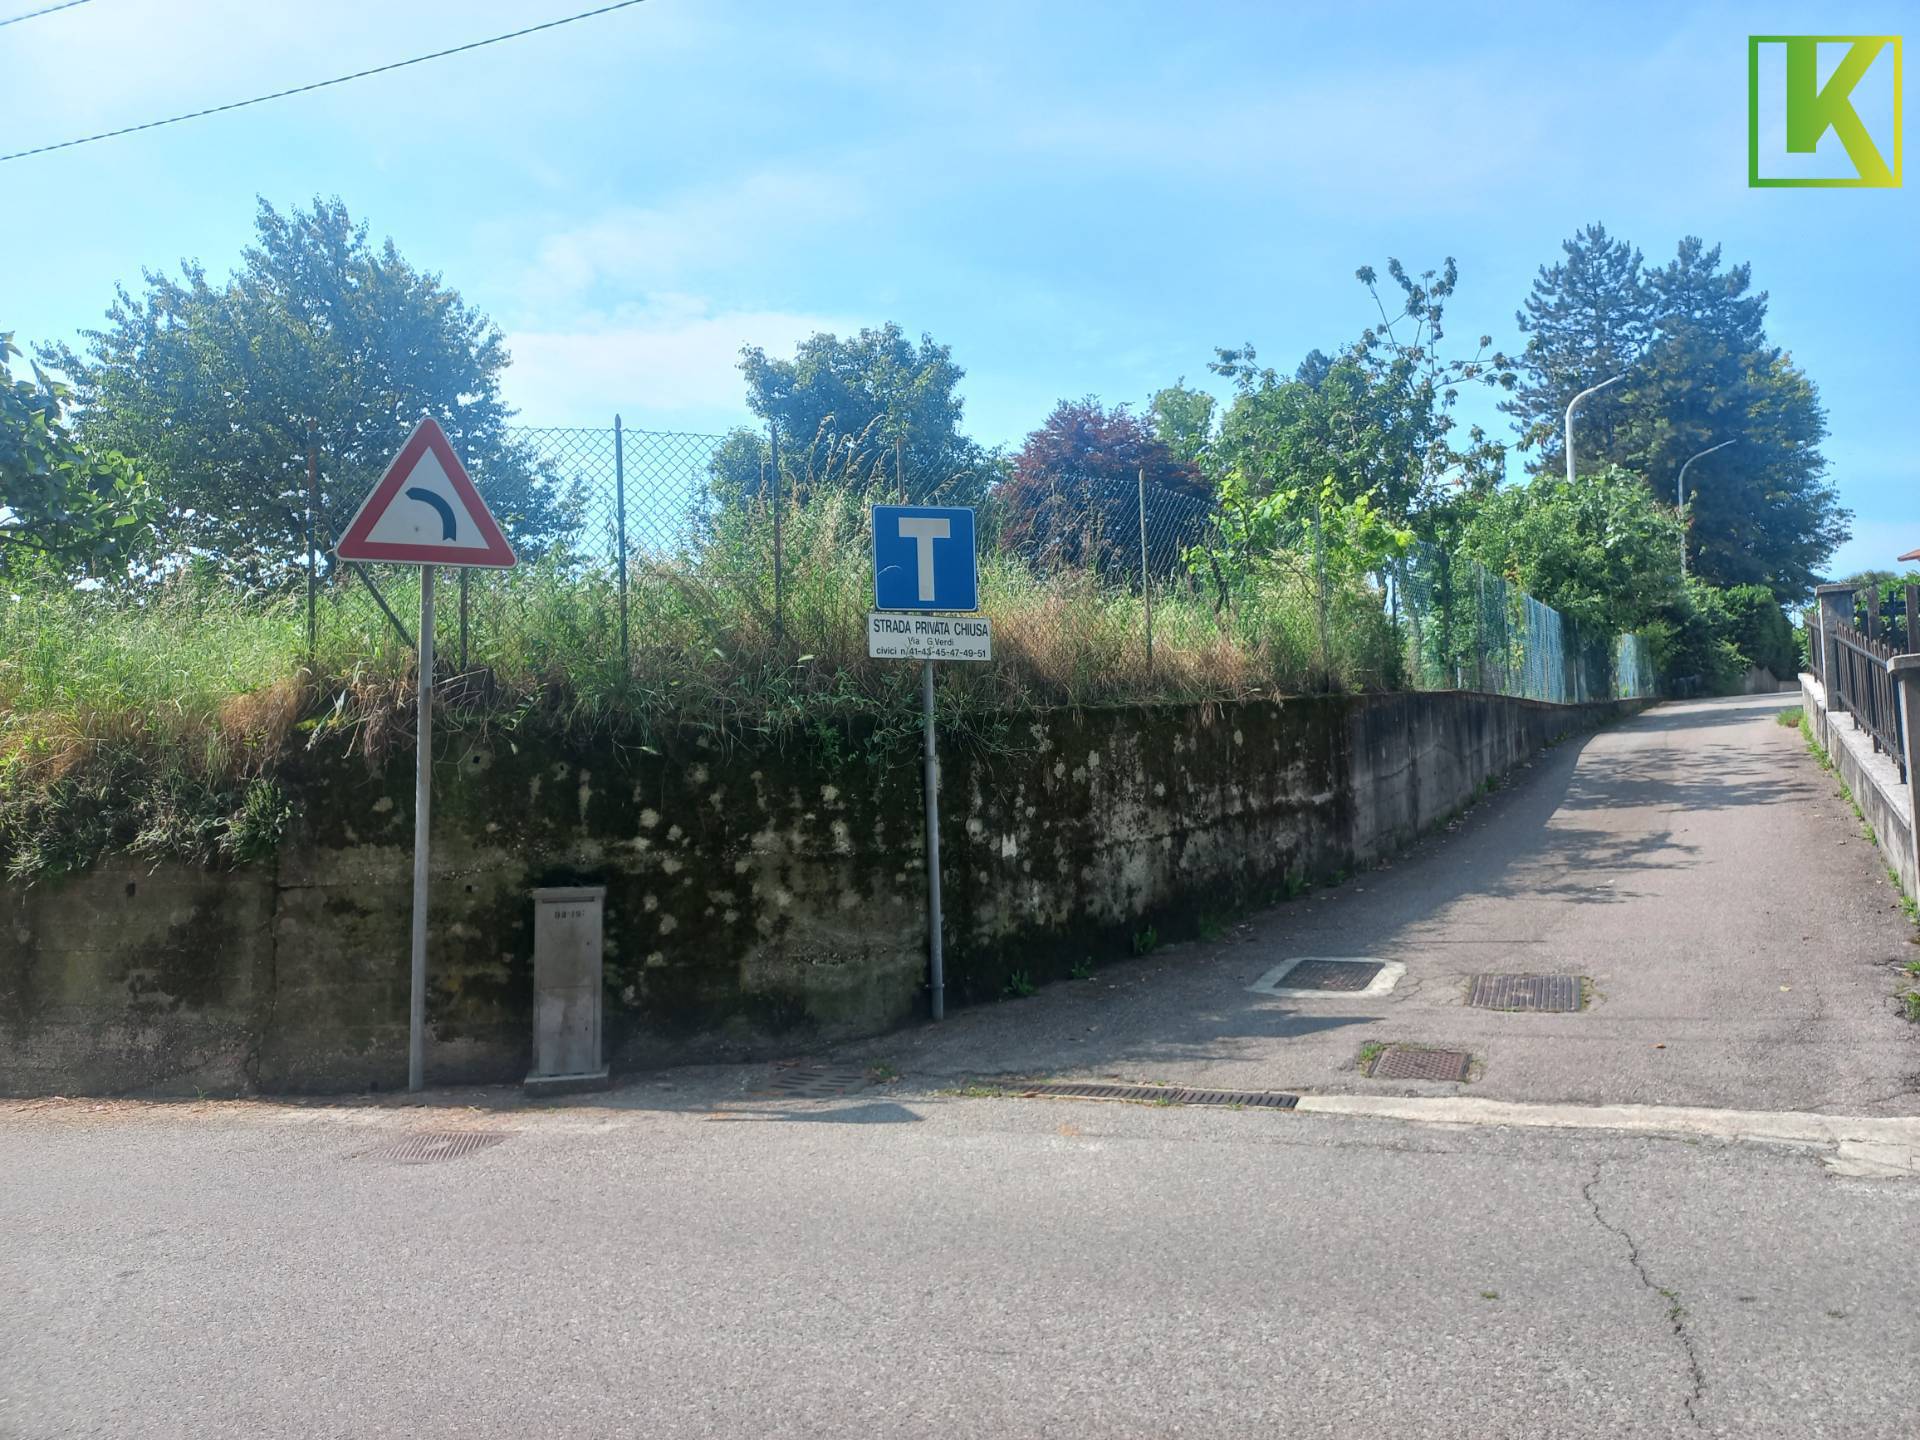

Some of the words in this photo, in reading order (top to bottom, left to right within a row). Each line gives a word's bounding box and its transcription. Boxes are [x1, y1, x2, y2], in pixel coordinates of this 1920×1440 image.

[873, 618, 911, 634] STRADA
[915, 621, 951, 635] PRIVATA
[954, 622, 989, 637] CHIUSA
[908, 636, 920, 645] Via
[876, 646, 897, 655] civici
